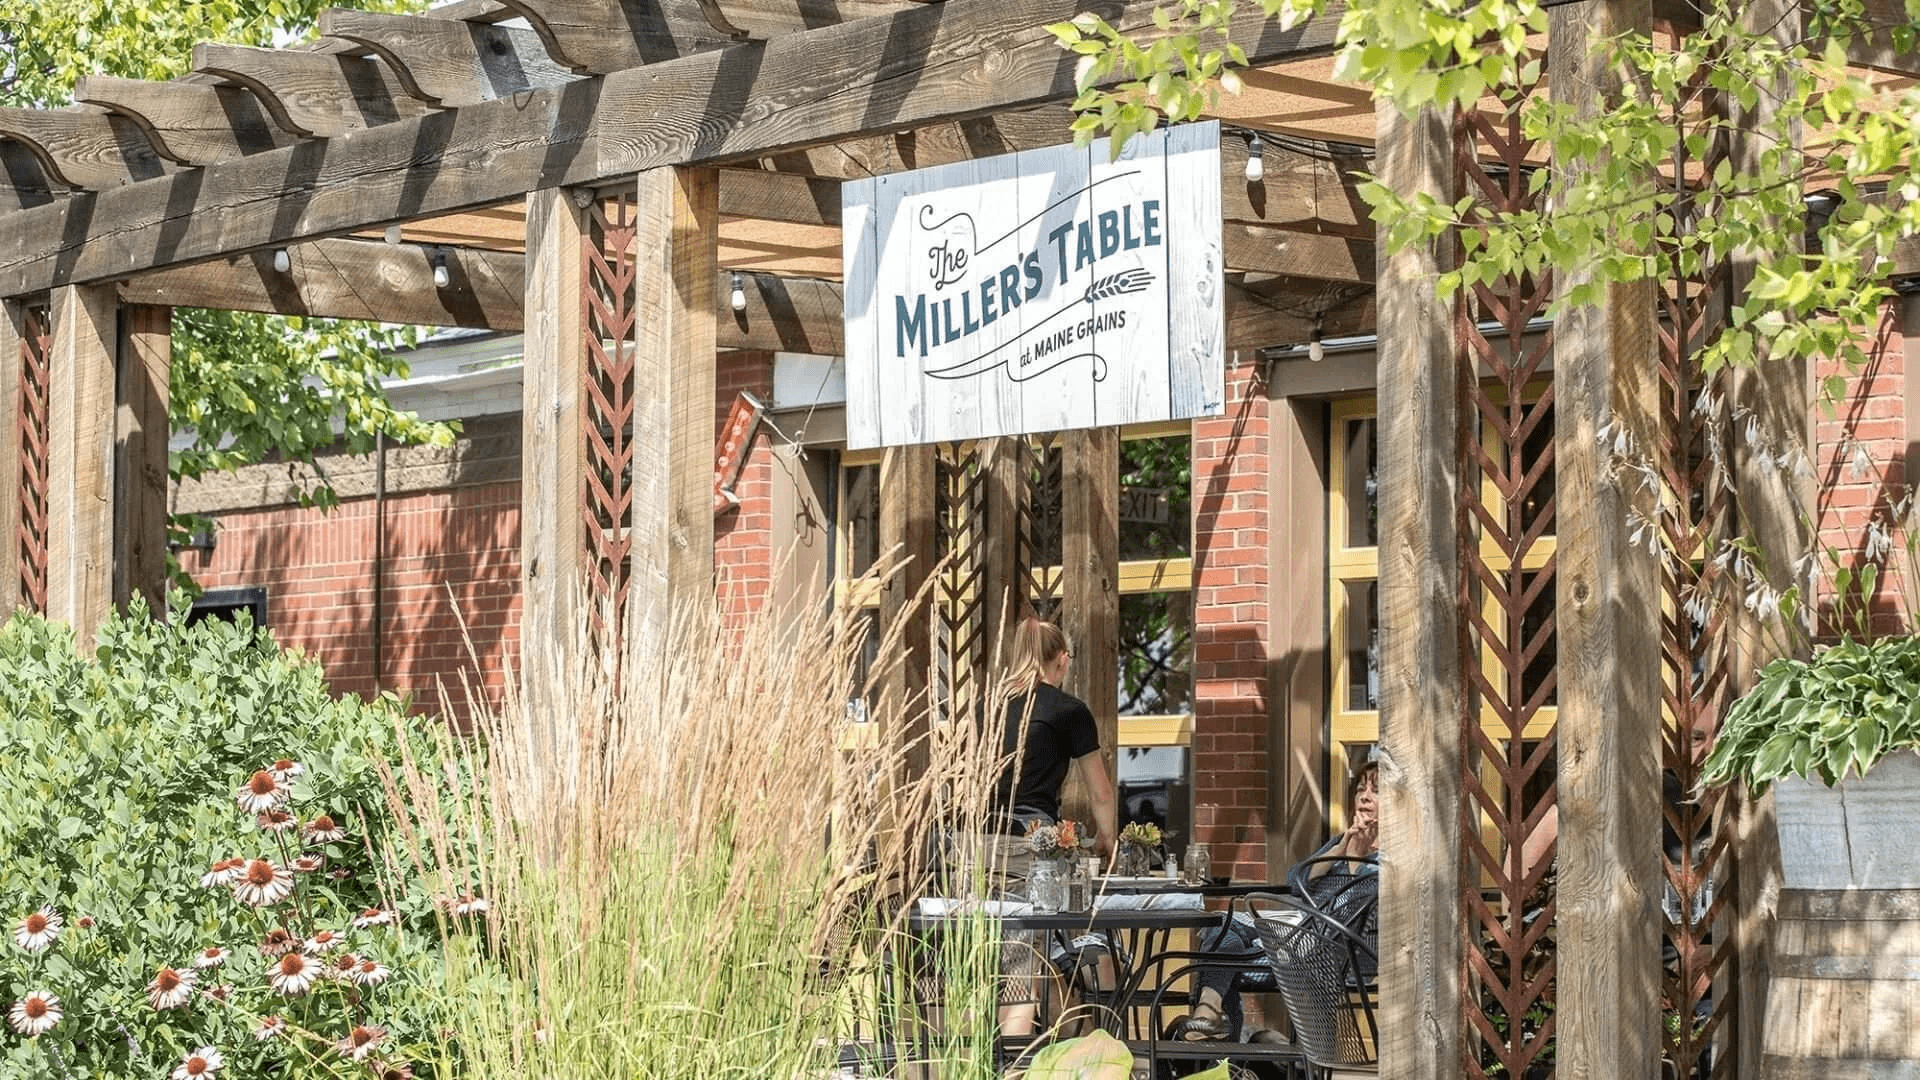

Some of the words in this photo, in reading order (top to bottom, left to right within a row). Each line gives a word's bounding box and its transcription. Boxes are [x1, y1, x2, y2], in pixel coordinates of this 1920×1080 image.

[895, 249, 1043, 357] MILLER'S
[1048, 200, 1161, 286] TABLE
[928, 239, 968, 291] The
[1020, 346, 1032, 368] at
[1034, 326, 1074, 361] MAINE
[1076, 310, 1126, 340] GRAINS
